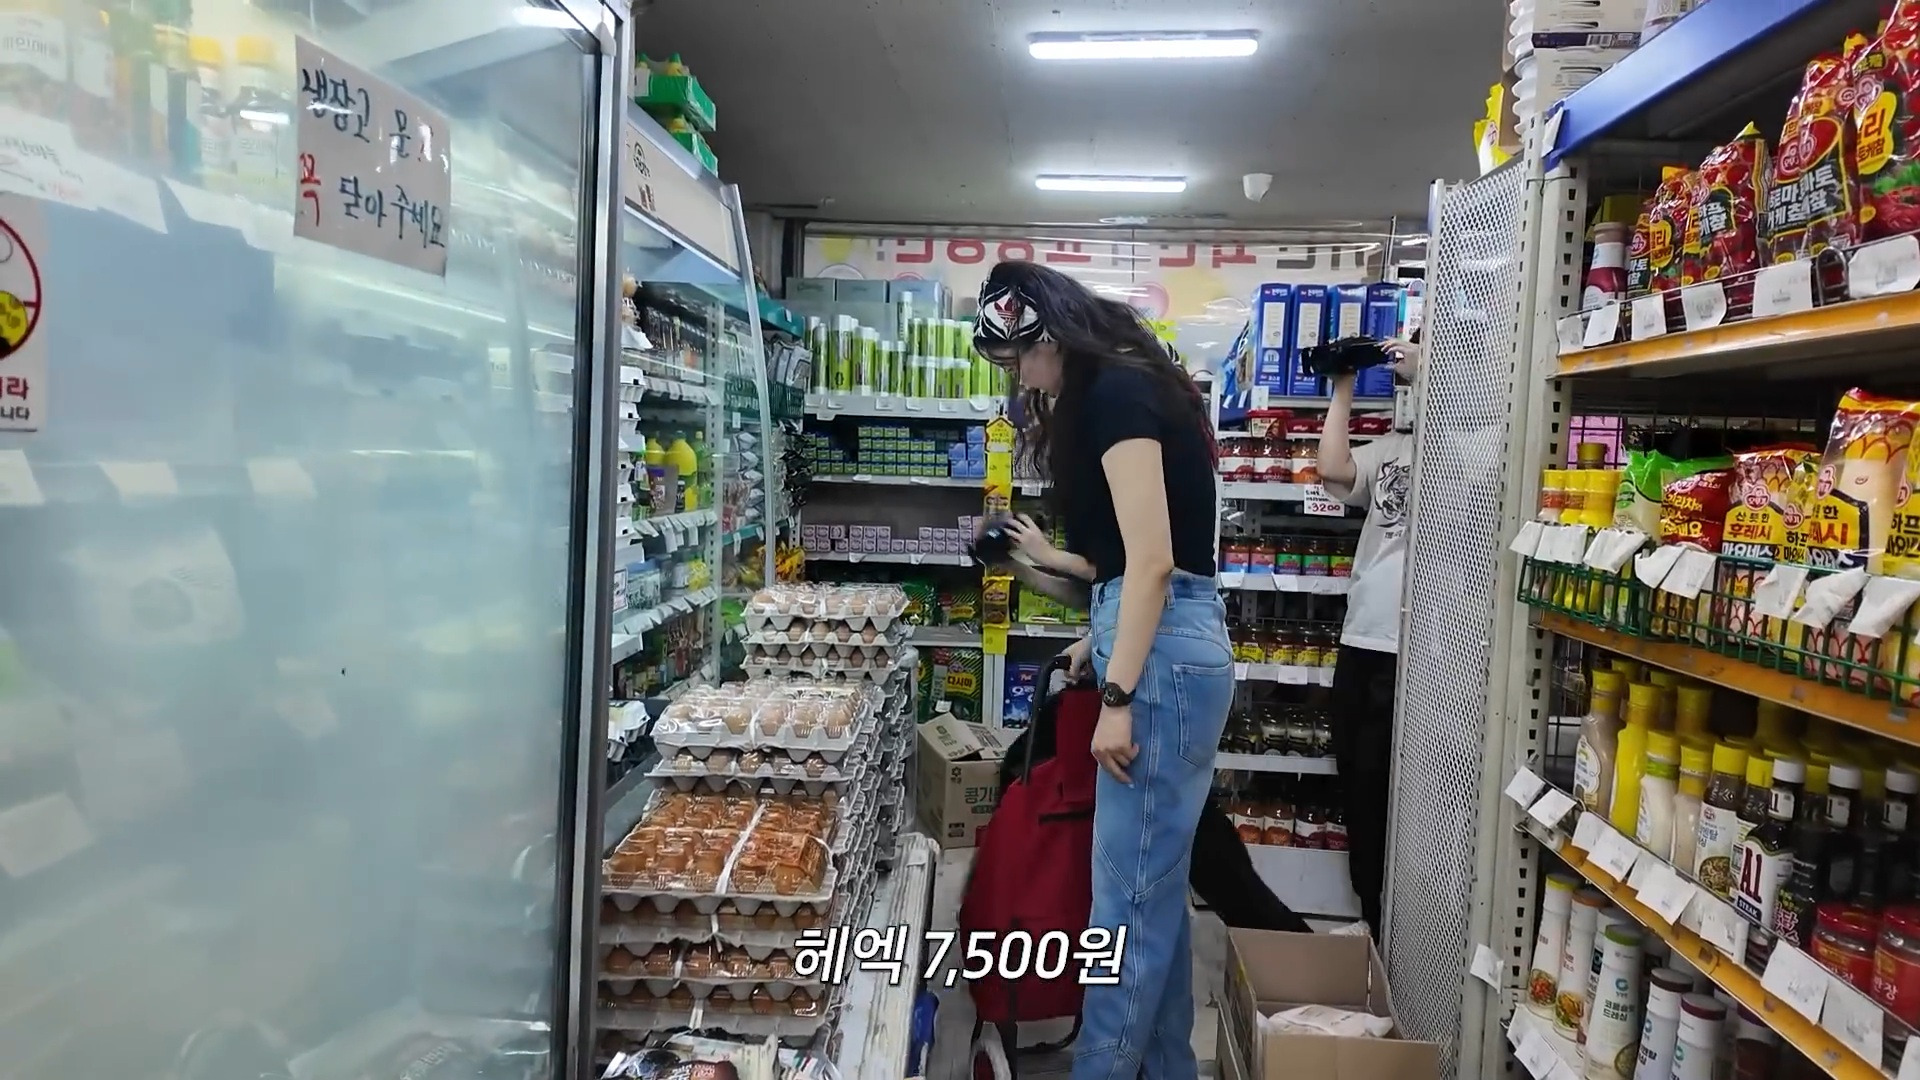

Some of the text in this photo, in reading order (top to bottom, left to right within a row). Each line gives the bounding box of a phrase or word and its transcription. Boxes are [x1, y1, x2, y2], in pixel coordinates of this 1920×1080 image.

[302, 68, 371, 143] 냉장고
[300, 152, 321, 227] 꼭
[0, 376, 30, 401] 라
[1729, 522, 1772, 545] 후레시
[1891, 513, 1920, 534] 하프
[1739, 900, 1758, 918] STEAK
[1603, 1008, 1628, 1022] 드레싱
